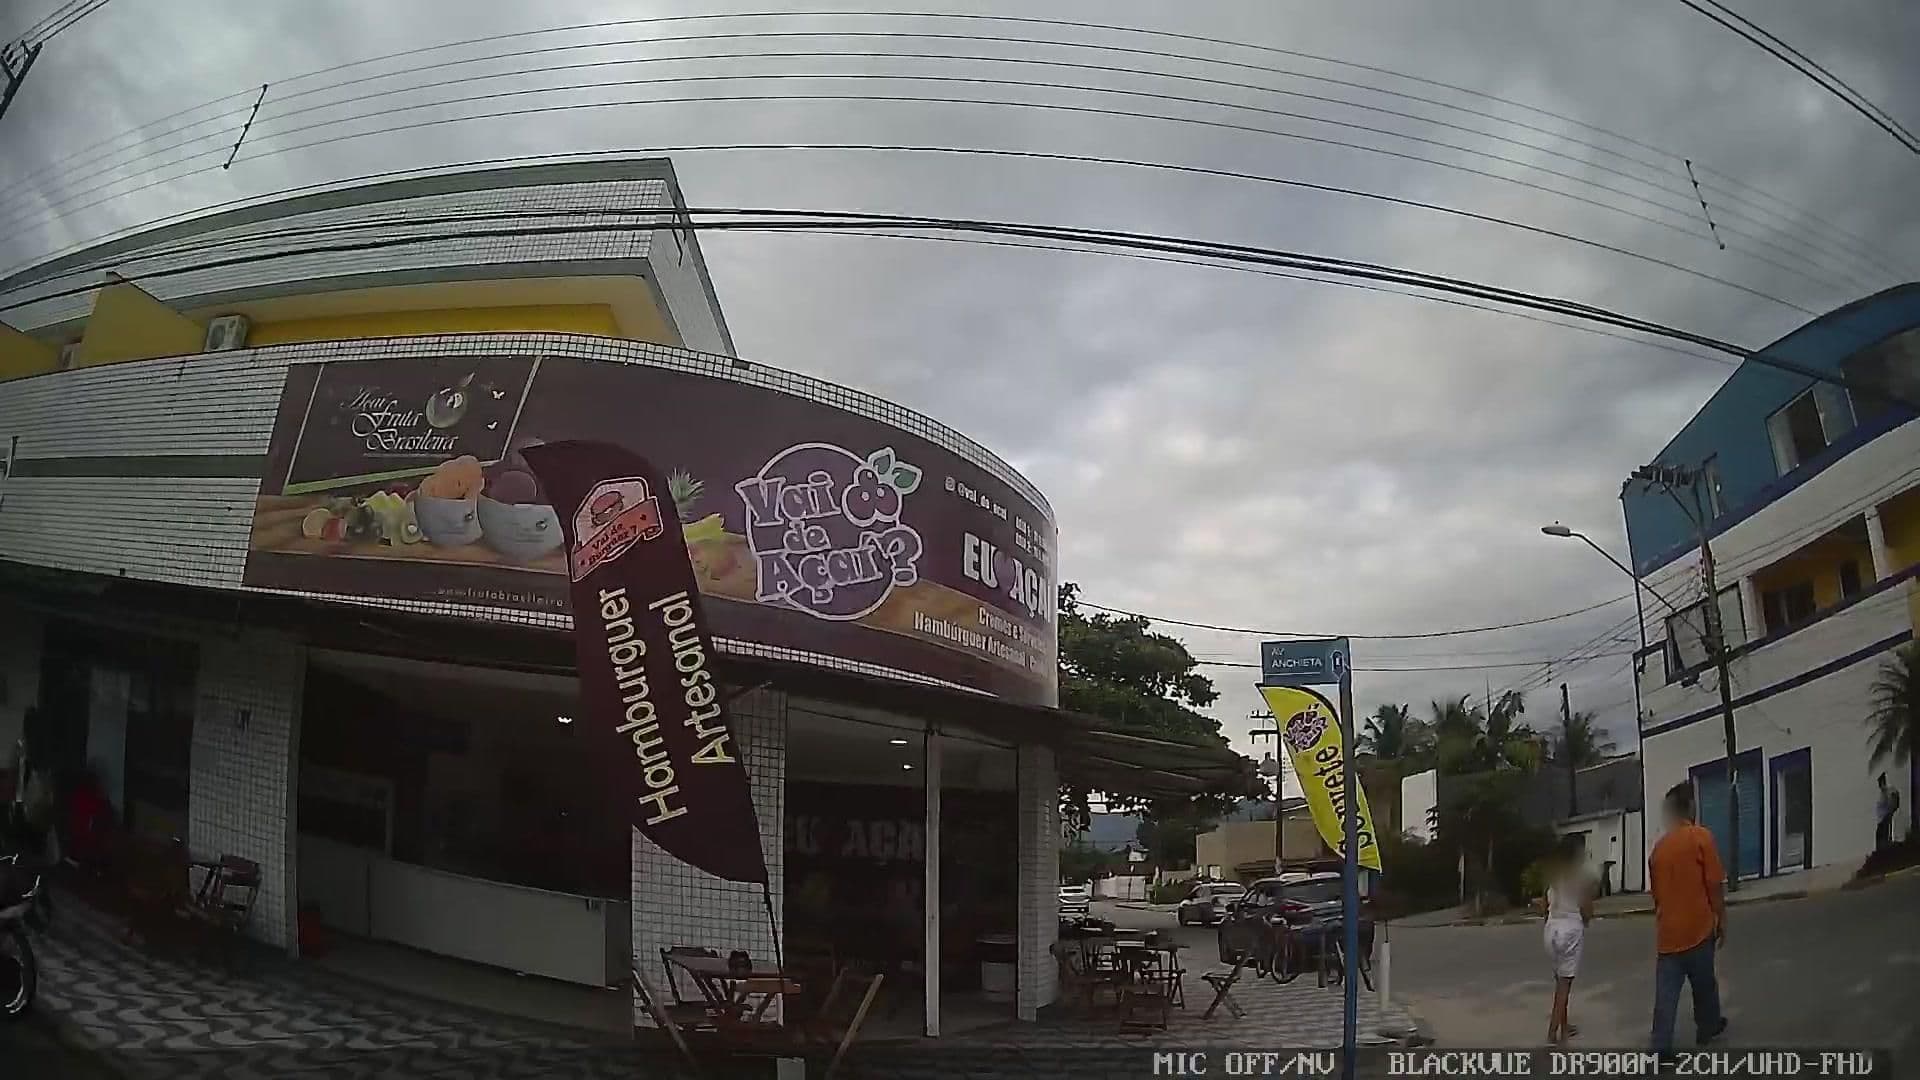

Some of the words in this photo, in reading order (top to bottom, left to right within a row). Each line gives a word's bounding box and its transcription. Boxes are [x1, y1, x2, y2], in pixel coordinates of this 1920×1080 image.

[735, 470, 842, 527] Vai
[783, 520, 832, 552] de
[963, 531, 999, 589] EU
[648, 590, 737, 764] Artesanal
[1271, 657, 1322, 668] ANCHIETA
[598, 587, 689, 826] Hamburguer
